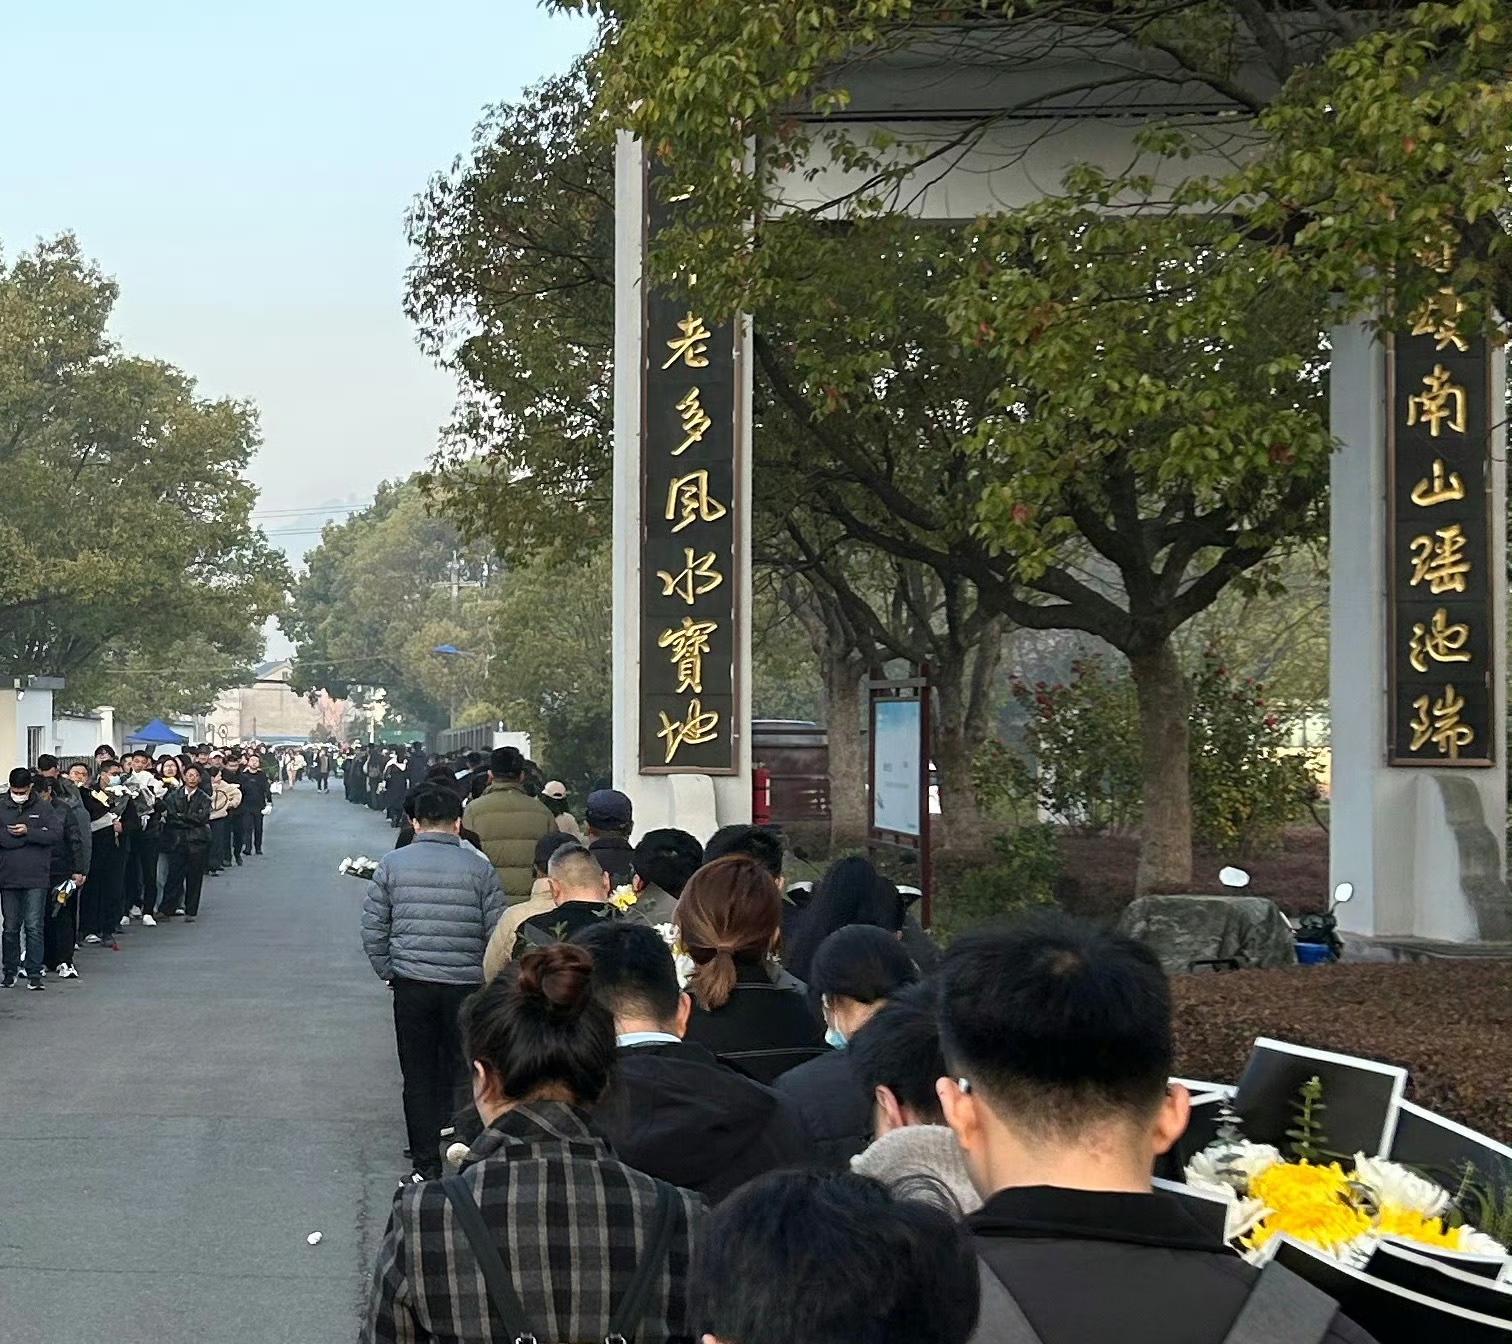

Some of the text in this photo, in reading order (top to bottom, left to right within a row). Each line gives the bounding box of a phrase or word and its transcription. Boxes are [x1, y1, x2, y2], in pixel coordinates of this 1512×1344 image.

[656, 184, 728, 763] 老多風水寶地
